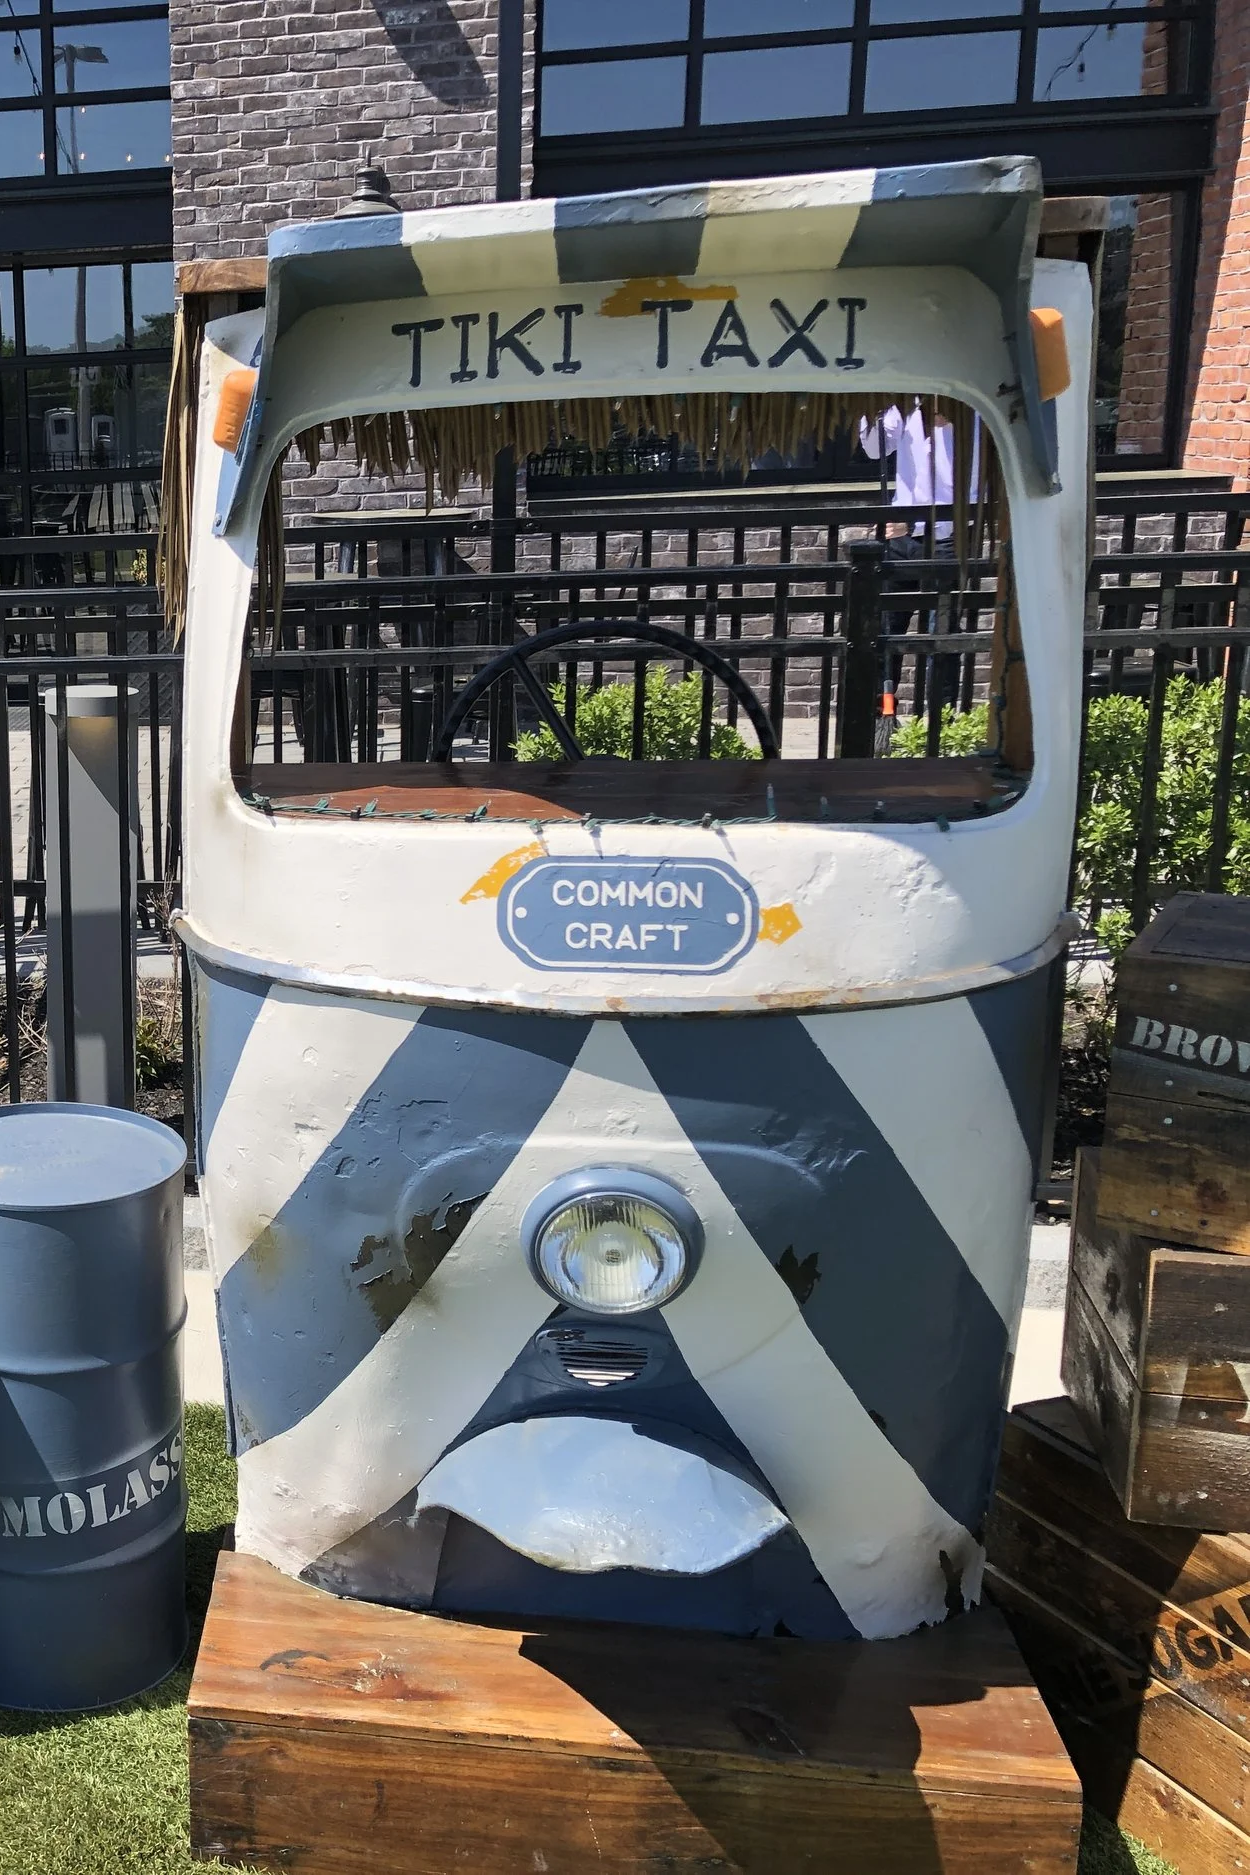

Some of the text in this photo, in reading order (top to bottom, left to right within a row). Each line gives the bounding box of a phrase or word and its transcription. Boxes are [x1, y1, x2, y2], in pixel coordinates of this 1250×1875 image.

[391, 297, 868, 388] TIKI TAXI
[551, 879, 704, 909] COMMON
[564, 922, 689, 951] CRAFT
